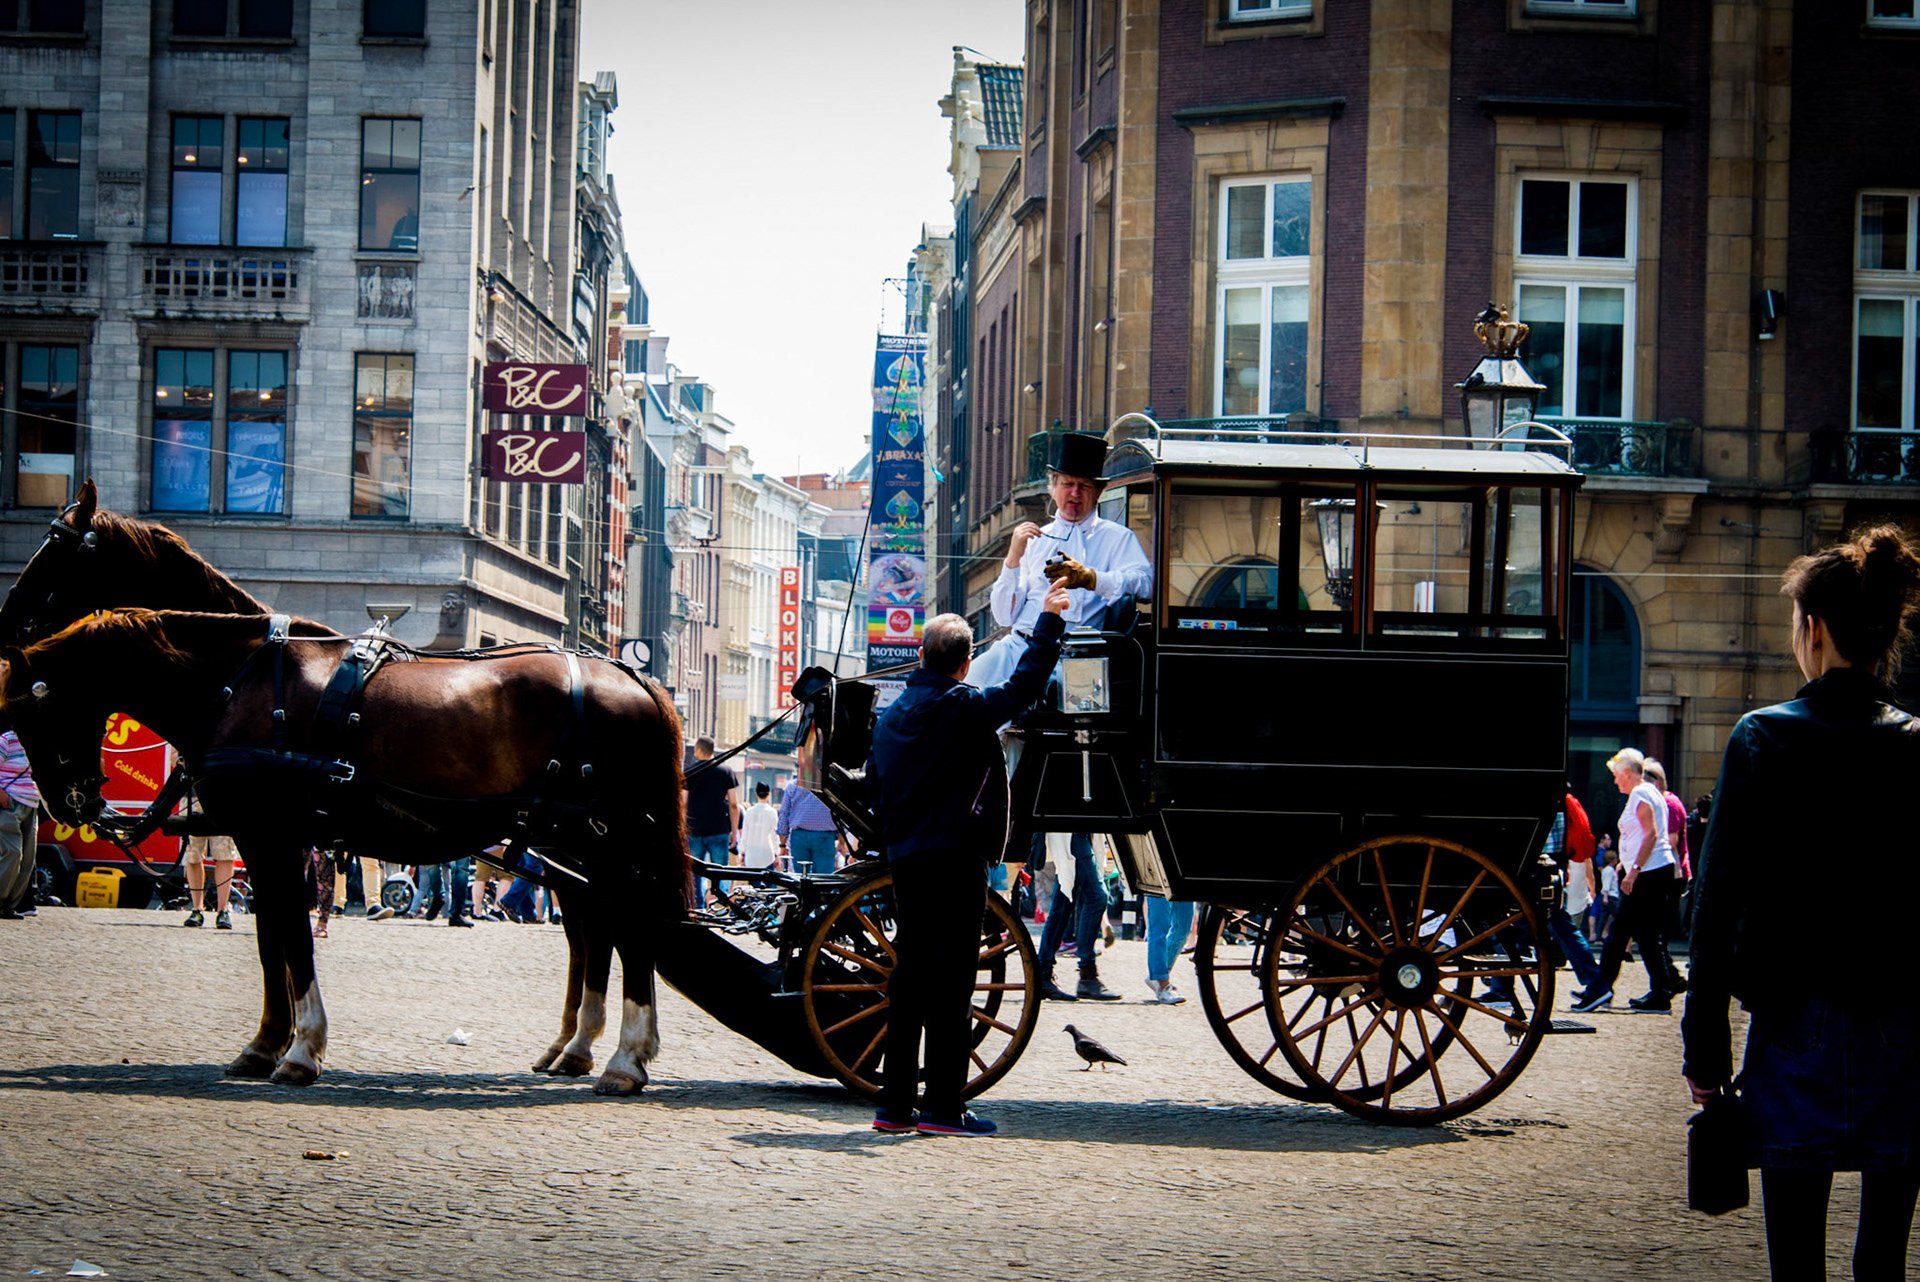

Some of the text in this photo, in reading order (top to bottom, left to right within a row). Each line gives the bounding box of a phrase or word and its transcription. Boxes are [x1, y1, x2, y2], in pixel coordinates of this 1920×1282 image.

[498, 366, 583, 410] P&C
[496, 434, 582, 478] P&C
[781, 569, 797, 707] BLOKKER
[114, 759, 159, 790] Cold drinks
